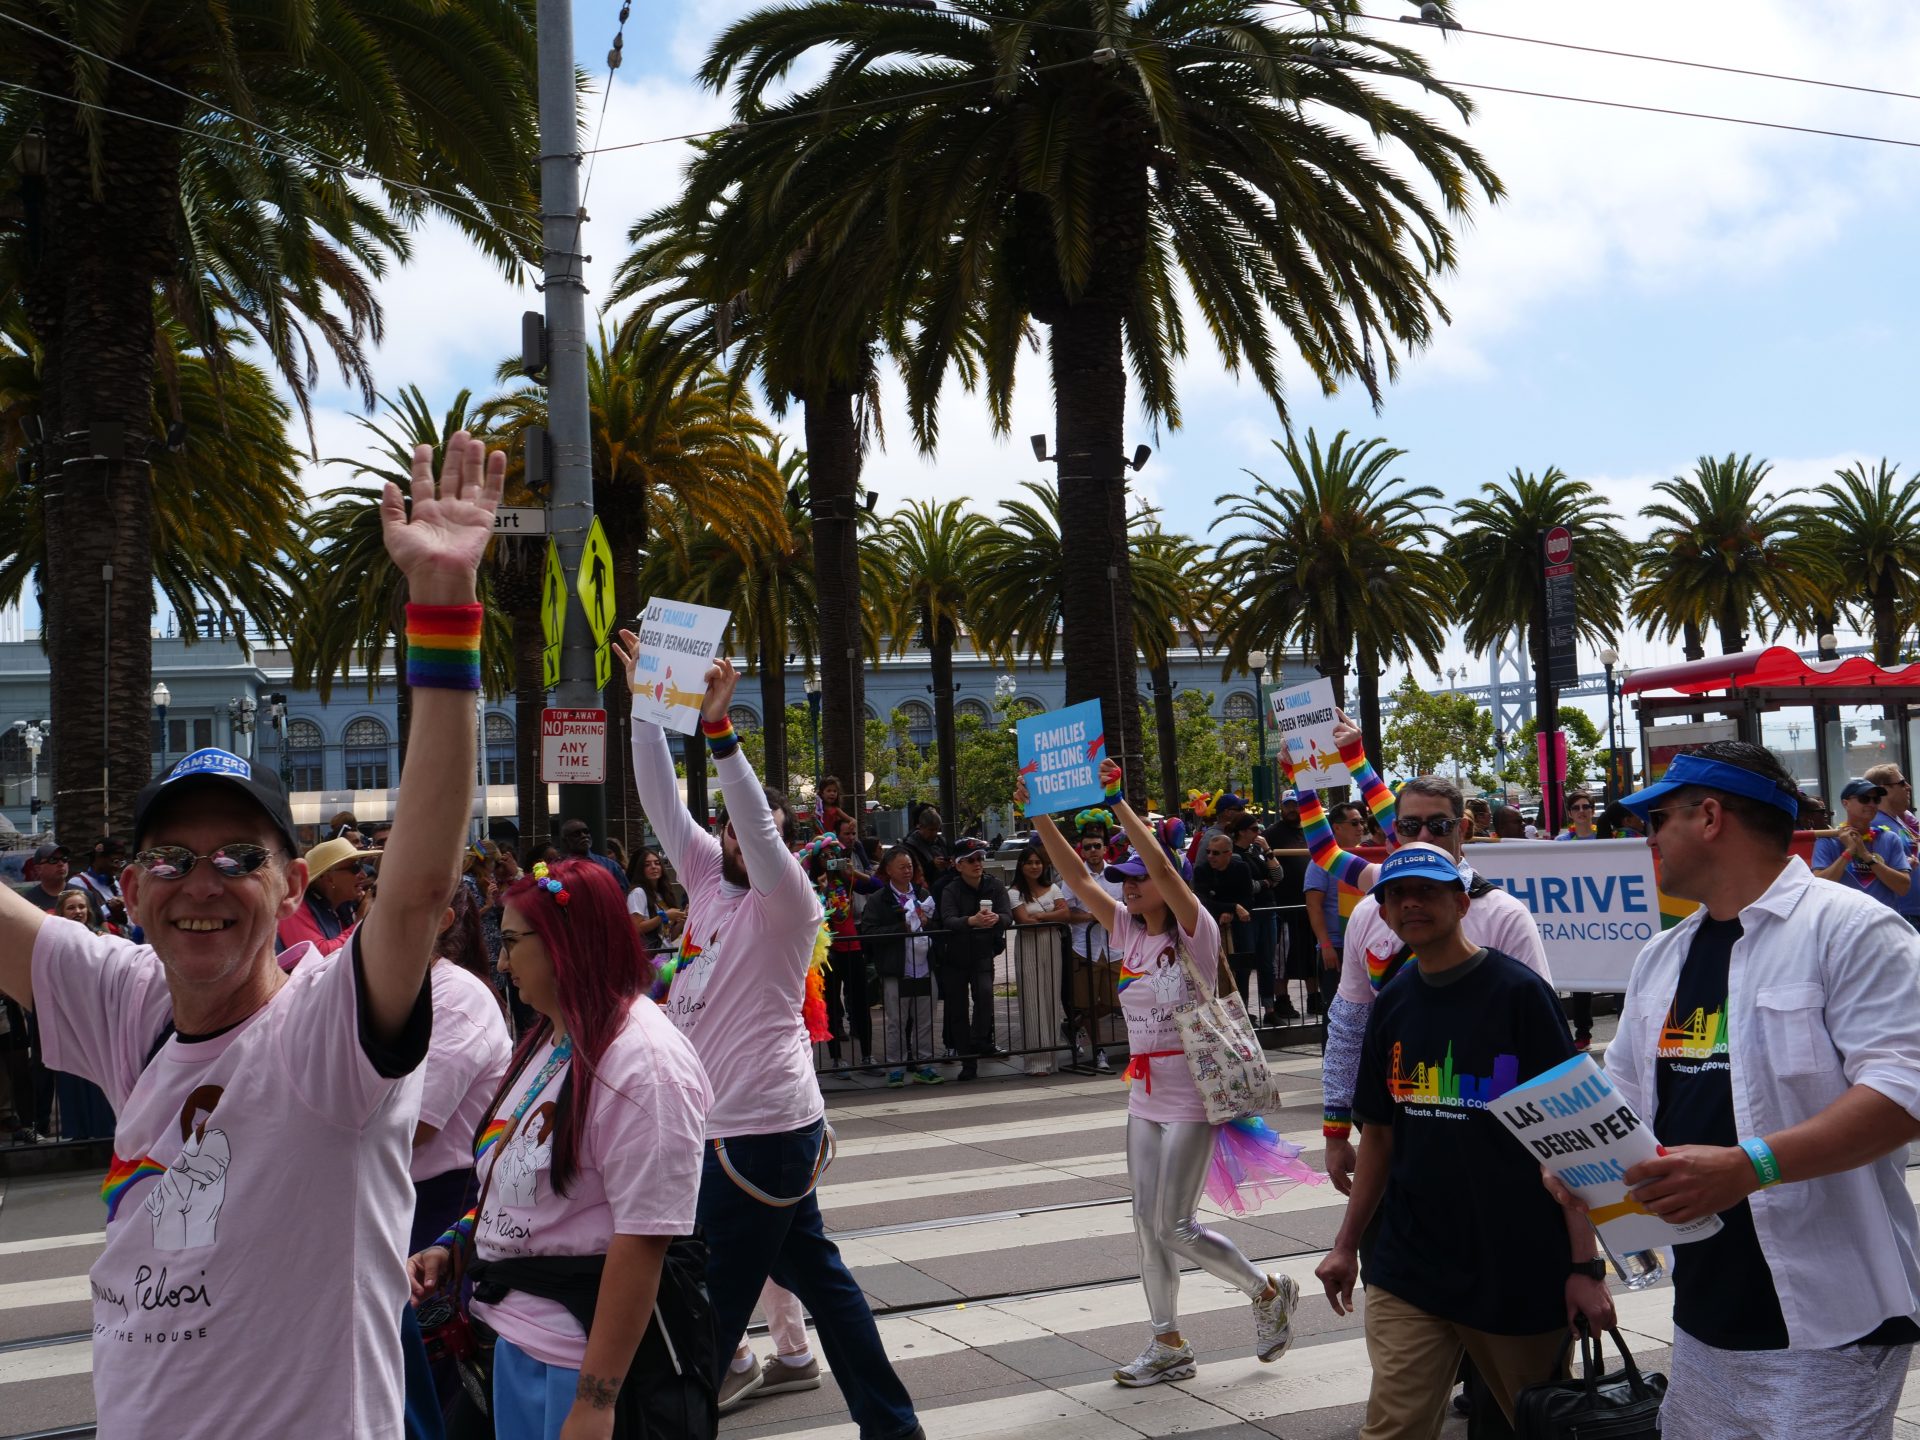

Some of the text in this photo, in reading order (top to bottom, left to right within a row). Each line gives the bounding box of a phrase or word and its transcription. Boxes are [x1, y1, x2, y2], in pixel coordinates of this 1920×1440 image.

[647, 606, 698, 628] LAS FAMILIAS
[640, 630, 713, 658] DEBEN PERMANECER
[639, 654, 660, 672] NIDAS
[1274, 690, 1312, 712] LAS FAMILIAS
[552, 711, 597, 720] TOW-AWAY
[1296, 708, 1334, 728] PERMANECER
[544, 721, 604, 735] NO PARKING
[1034, 721, 1086, 752] FAMILIES
[560, 742, 587, 753] ANY
[1287, 736, 1304, 751] NIDAS
[174, 754, 246, 775] EAMSTERS
[557, 756, 589, 767] TIME
[1040, 745, 1083, 772] BELONG
[1034, 766, 1093, 795] TOGETHER
[1404, 854, 1426, 863] Local
[1503, 1101, 1545, 1129] LAS
[1530, 1128, 1596, 1159] DEBEN
[1557, 1158, 1626, 1188] UNIDAS
[134, 1264, 211, 1310] Pelosi
[114, 1330, 133, 1342] THE
[145, 1327, 207, 1343] HOUSE
